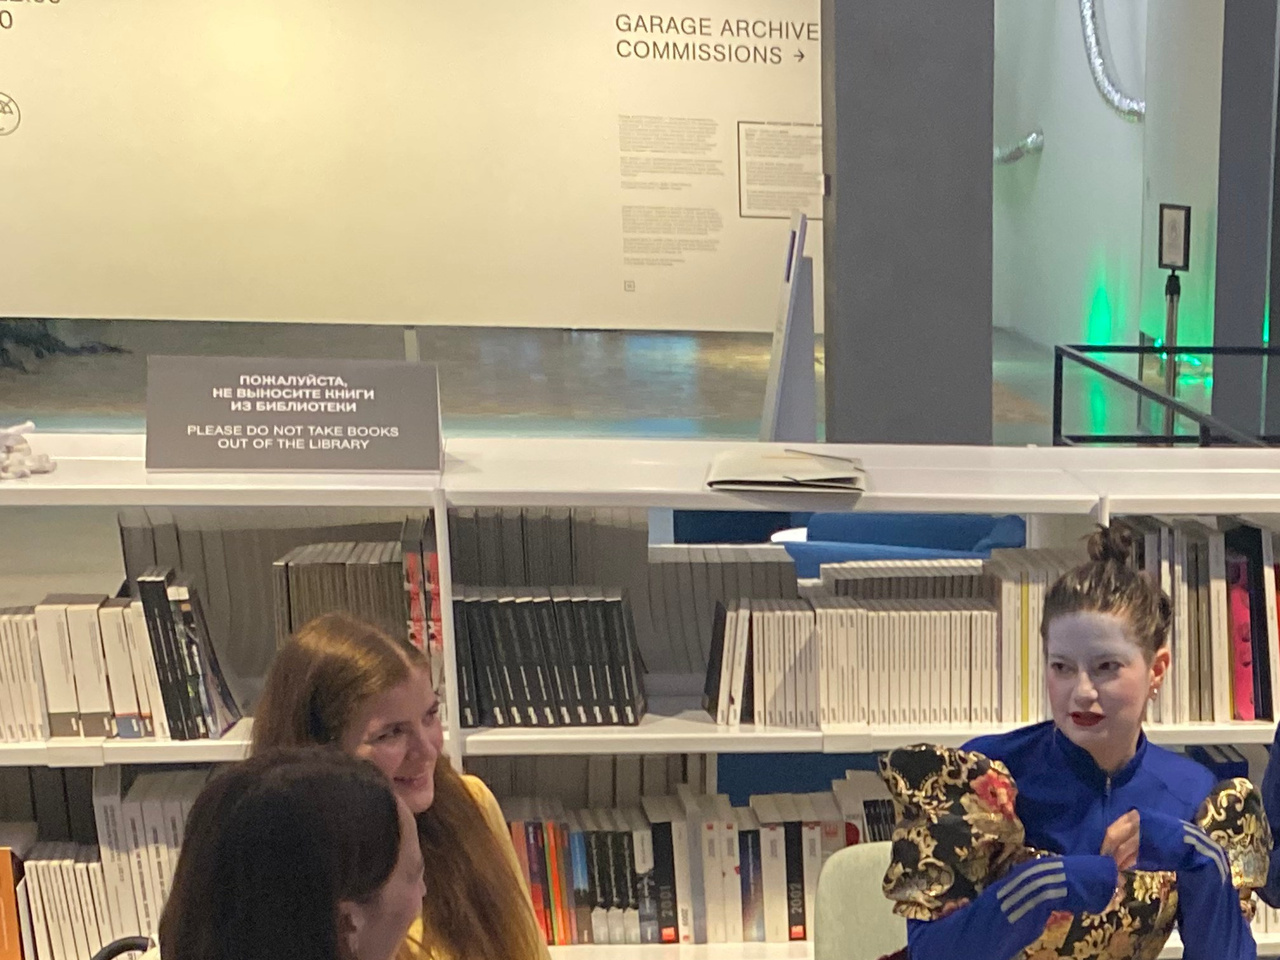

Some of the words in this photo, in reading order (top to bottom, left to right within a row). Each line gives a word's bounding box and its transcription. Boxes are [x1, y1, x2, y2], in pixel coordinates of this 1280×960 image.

[615, 13, 712, 37] GARAGE
[719, 18, 820, 41] ARCHIVE
[616, 39, 783, 65] COMMISSIONS
[239, 374, 348, 387] ПОЖАЛУЙСТА,
[212, 387, 233, 398] НЕ
[236, 388, 322, 400] ВЫНОСИТЕ
[324, 388, 375, 400] КНИГИ
[230, 400, 252, 411] ИЗ
[255, 401, 357, 413] БИБЛИОТЕКИ
[187, 425, 243, 436] PLEASE
[246, 425, 270, 436] DO
[273, 425, 304, 436] NOT
[307, 425, 344, 437] TAKE
[347, 426, 400, 437] BOOKS
[217, 438, 249, 449] OUT
[252, 438, 274, 449] OF
[277, 438, 306, 449] THE
[308, 438, 370, 450] LIBRARY
[659, 886, 674, 918] 2001
